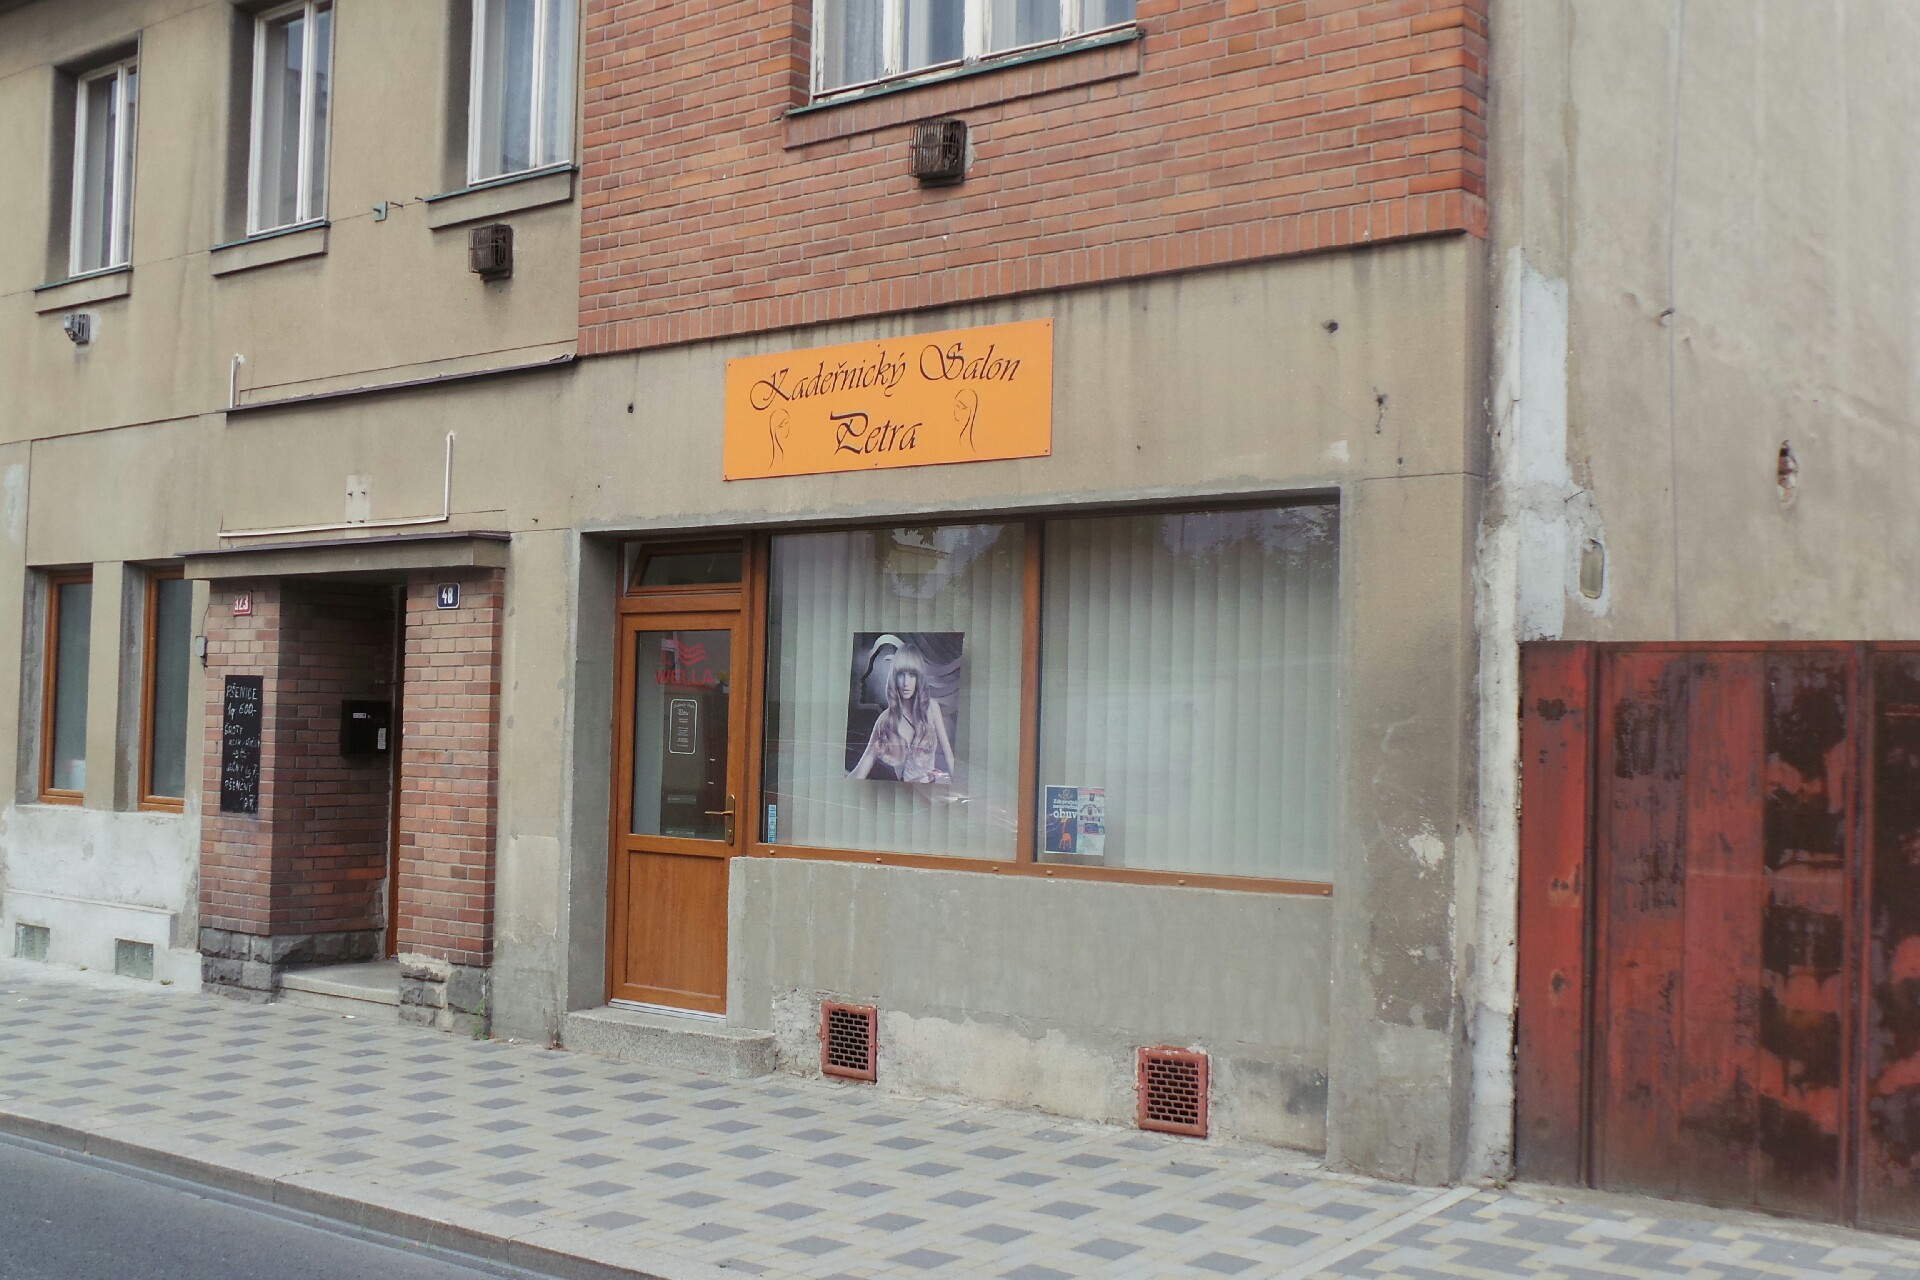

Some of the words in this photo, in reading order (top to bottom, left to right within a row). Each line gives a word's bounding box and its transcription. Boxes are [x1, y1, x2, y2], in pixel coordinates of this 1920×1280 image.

[750, 350, 906, 410] Kadeřnický
[919, 342, 1021, 382] Salon
[830, 411, 922, 455] Petra
[441, 587, 453, 604] 48
[655, 668, 715, 686] WELLA
[226, 682, 258, 700] PŠENICE
[1053, 808, 1077, 819] obuv
